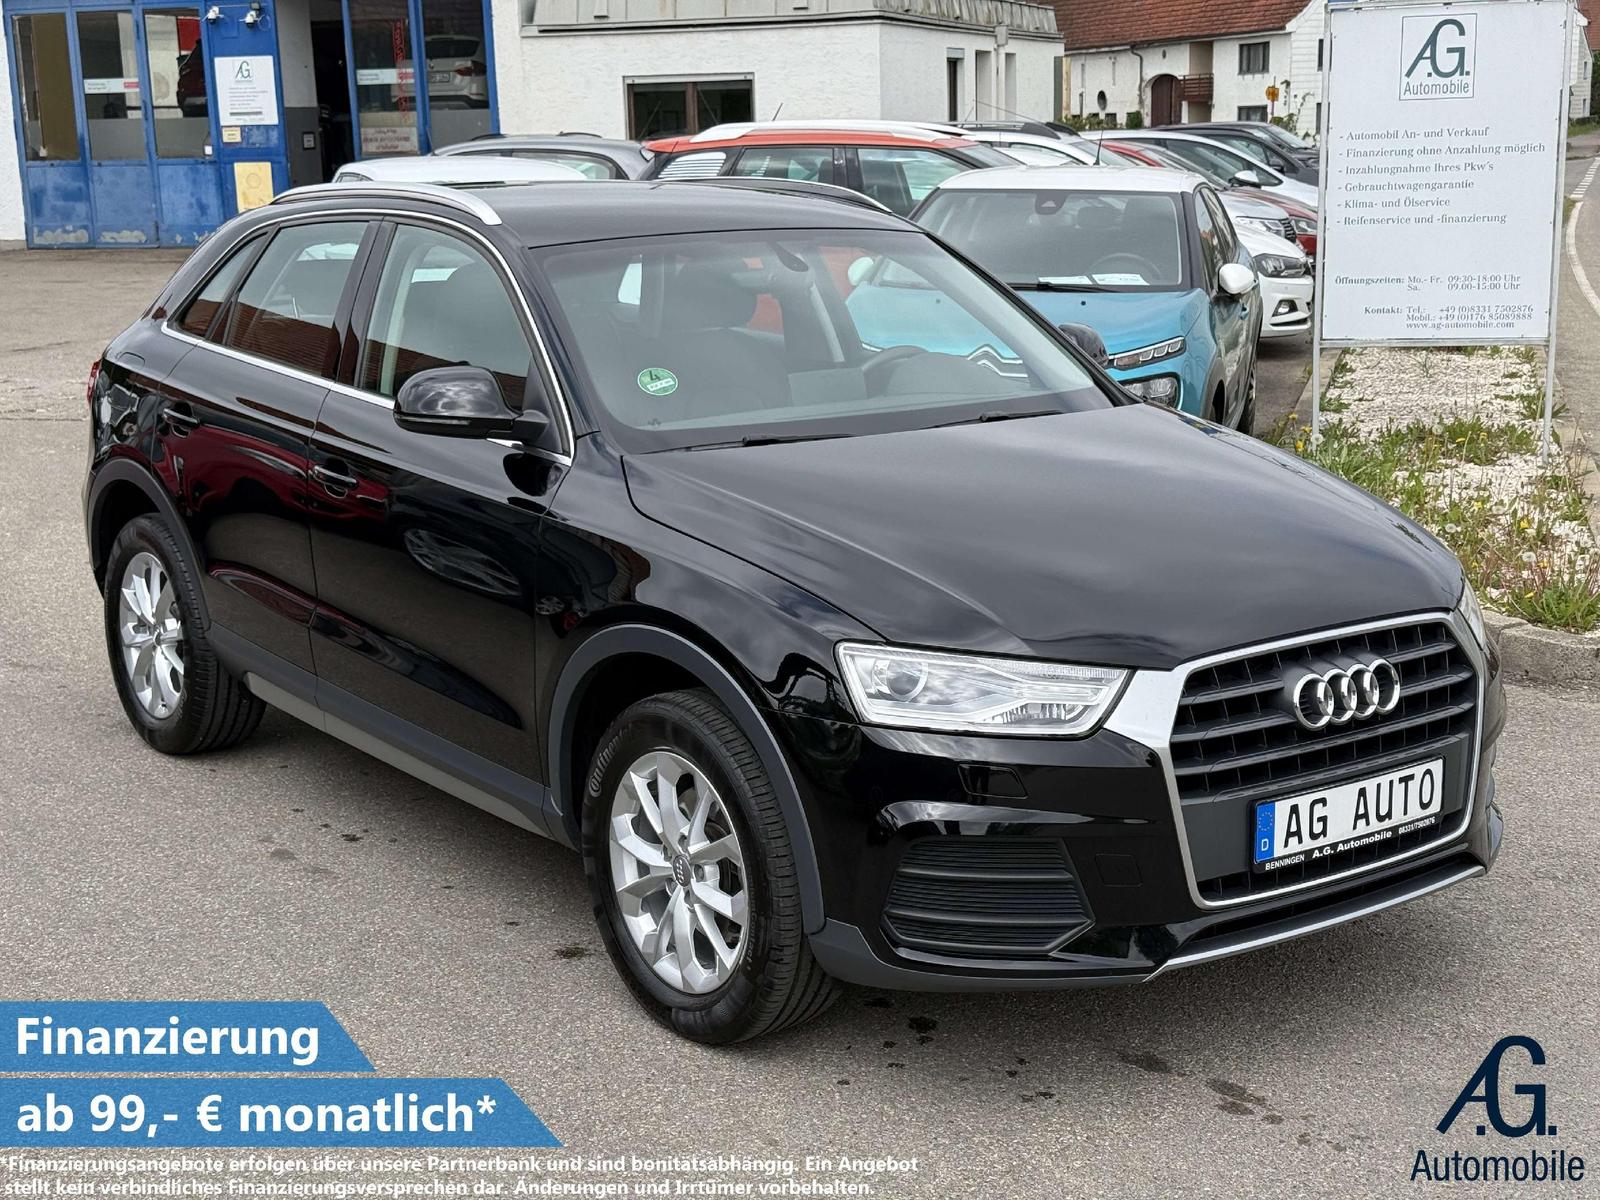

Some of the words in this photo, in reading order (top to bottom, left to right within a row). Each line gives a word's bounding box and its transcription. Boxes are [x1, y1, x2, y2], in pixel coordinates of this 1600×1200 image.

[1404, 18, 1470, 78] A.G.
[1403, 79, 1470, 96] Automobile
[1346, 129, 1399, 141] Automobil
[1401, 128, 1421, 139] An-
[1424, 128, 1443, 138] und
[1447, 126, 1490, 137] Verkauf
[1346, 147, 1414, 158] Finanzierung
[1416, 146, 1442, 155] ohne
[1444, 144, 1501, 155] Anzahlung
[1504, 143, 1545, 154] möglich
[1345, 163, 1431, 175] Inzahlungnahme
[1434, 162, 1461, 172] Ihres
[1344, 179, 1474, 192] Gebrauchtwagengarantie
[1344, 199, 1378, 209] Klima-
[1381, 198, 1401, 208] und
[1404, 196, 1450, 207] Ölservice
[1343, 215, 1411, 226] Reifenservice
[1414, 214, 1434, 224] und
[1437, 213, 1507, 225] -finanzierung
[1335, 275, 1404, 286] Öffnungszeiten:
[1503, 274, 1521, 282] Uhr
[1407, 283, 1421, 291] Sa.
[1503, 282, 1521, 290] Uhr
[1364, 306, 1403, 314] Kontakt:
[1405, 320, 1515, 330] www.ag-automobile.com
[1283, 797, 1328, 849] AG
[1352, 768, 1435, 831] AUTO
[1261, 838, 1269, 851] D
[1265, 853, 1305, 871] BENNINGEN
[1312, 846, 1335, 859] A.G.
[1337, 831, 1392, 852] Automobile
